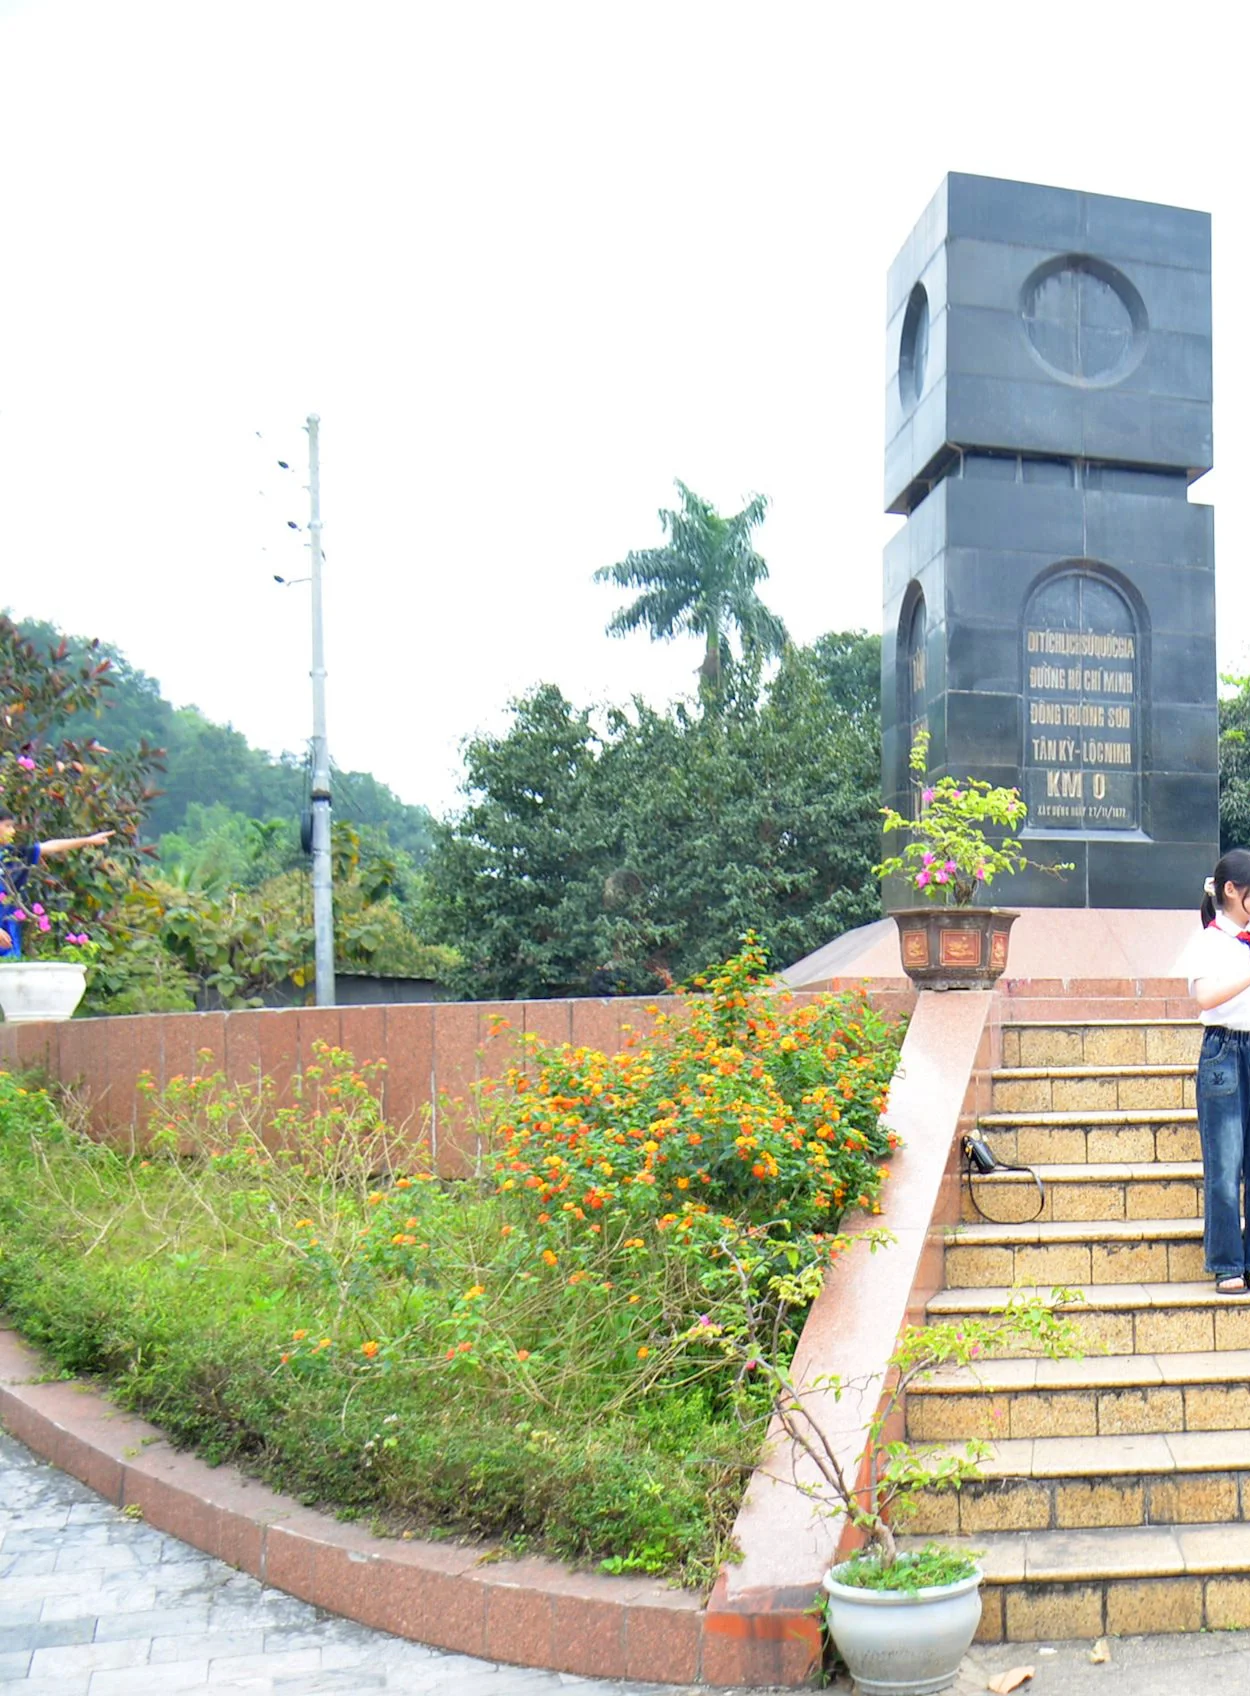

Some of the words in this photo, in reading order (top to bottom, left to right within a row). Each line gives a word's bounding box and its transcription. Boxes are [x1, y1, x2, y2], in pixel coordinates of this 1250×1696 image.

[1083, 666, 1103, 691] CHÍ
[1103, 670, 1133, 693] MINH
[1032, 735, 1057, 761] TÂN
[1104, 742, 1131, 764] NINH
[1047, 770, 1082, 798] KM
